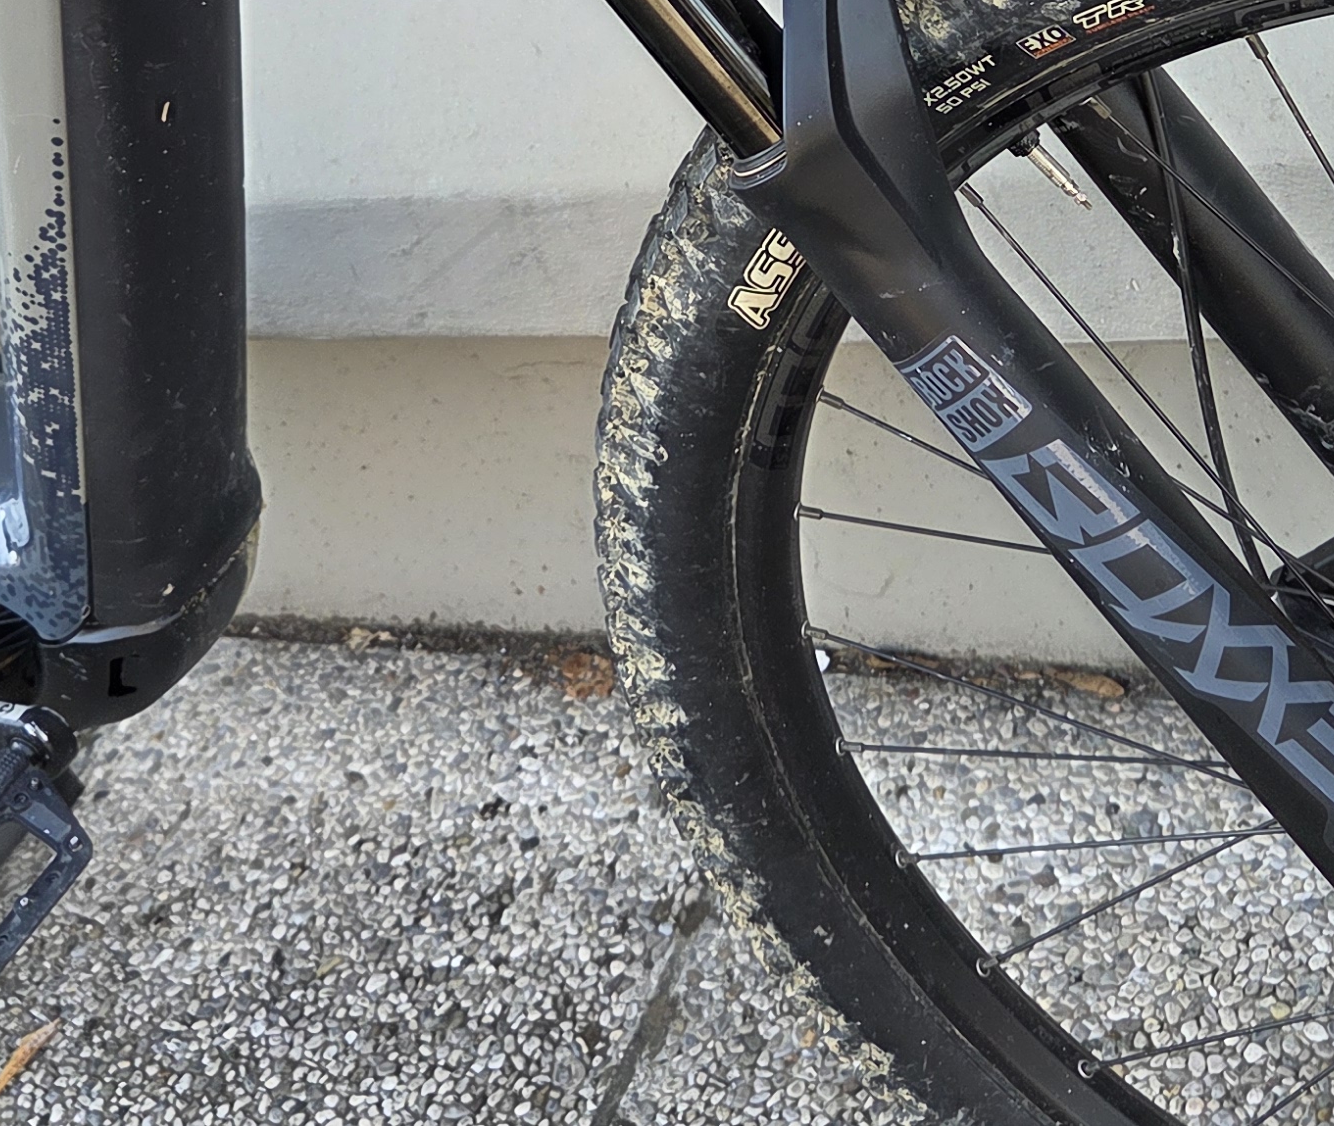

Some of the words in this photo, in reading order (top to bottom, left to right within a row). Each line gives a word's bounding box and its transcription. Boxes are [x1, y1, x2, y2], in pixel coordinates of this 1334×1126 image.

[1020, 25, 1072, 54] EXO
[935, 96, 964, 115] 50
[959, 78, 992, 100] PSI
[909, 348, 981, 406] ROCK
[946, 381, 1020, 443] SHOX
